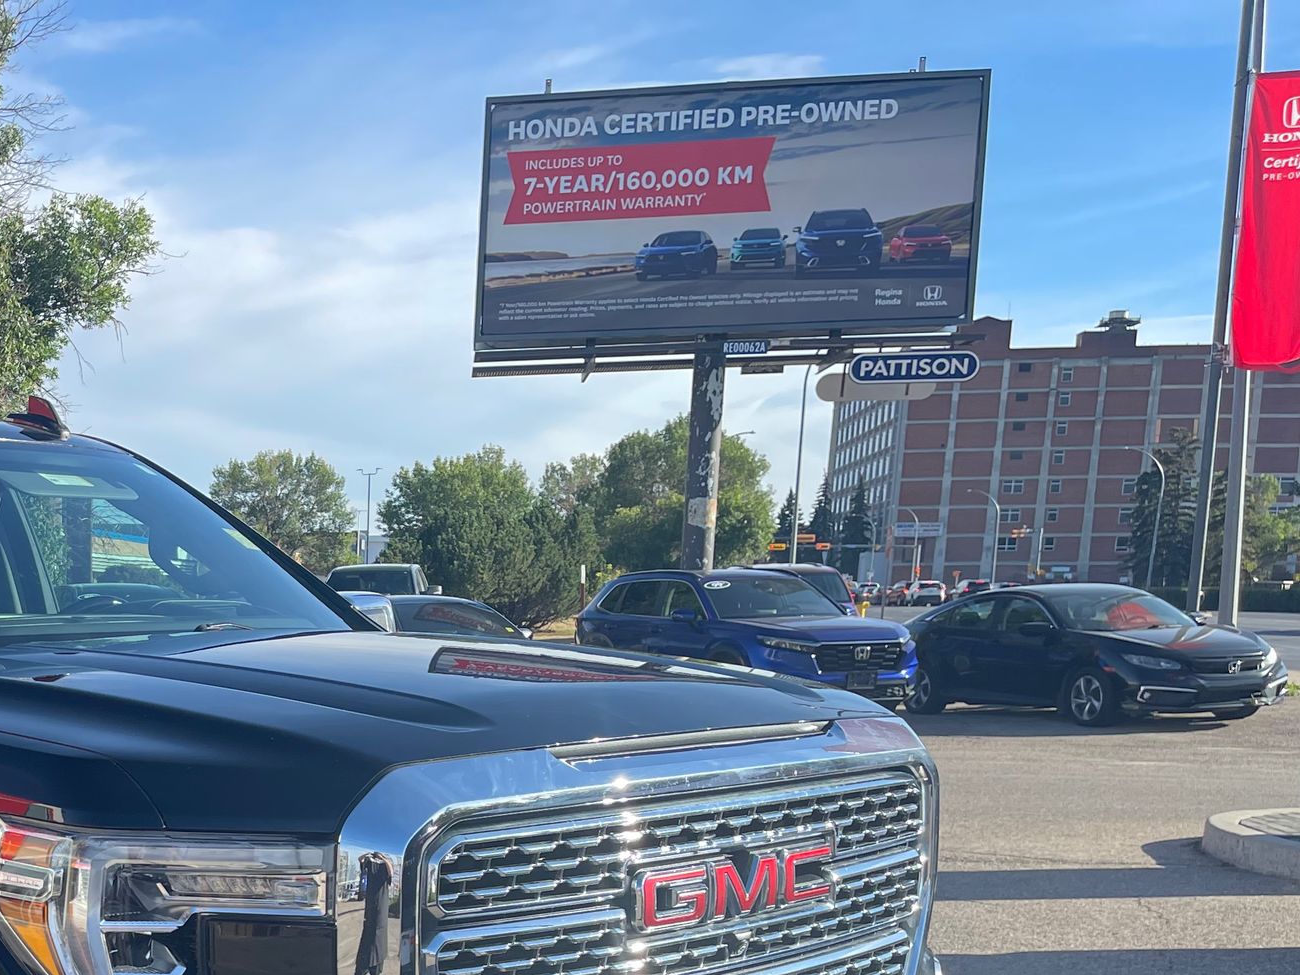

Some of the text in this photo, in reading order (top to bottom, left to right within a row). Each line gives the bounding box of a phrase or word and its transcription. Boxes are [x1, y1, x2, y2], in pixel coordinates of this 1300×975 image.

[508, 98, 899, 140] HONDA CERTIFIED PRE-OWNED
[525, 154, 623, 170] INCLUDES UP TO
[524, 166, 754, 196] 7-YEAR/160,000 KM
[523, 199, 616, 215] POWERTRAIN
[875, 288, 902, 298] Regina
[875, 298, 901, 306] Honda
[723, 342, 766, 353] RE00062A
[859, 357, 969, 378] PATTISON
[631, 846, 833, 934] GMC
